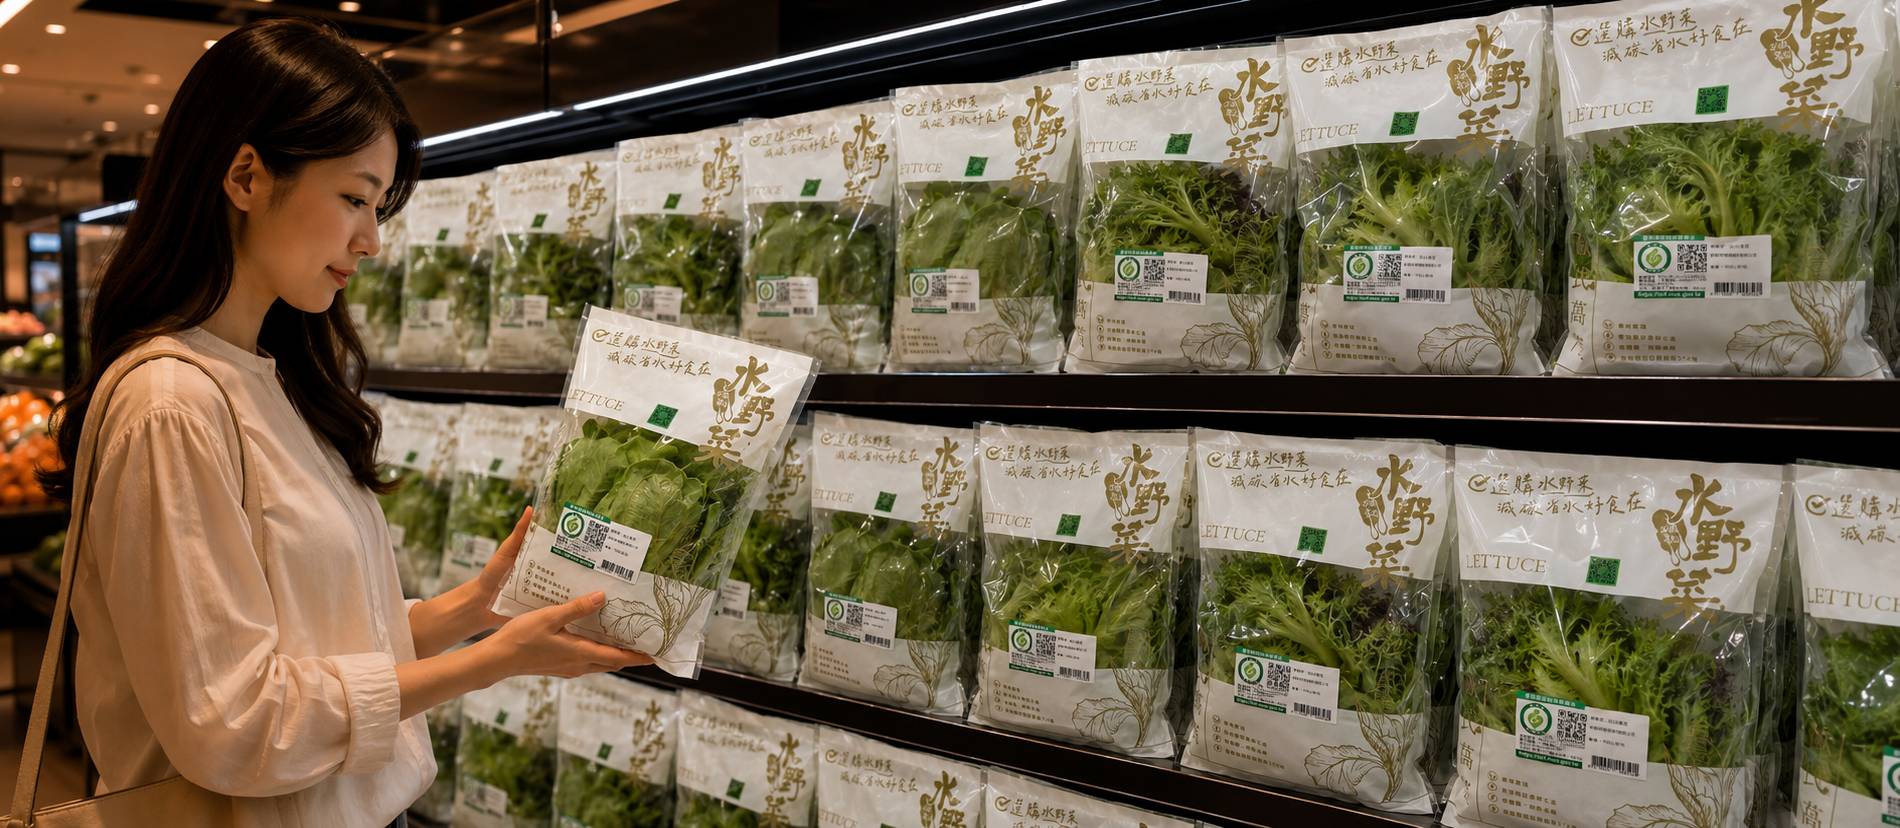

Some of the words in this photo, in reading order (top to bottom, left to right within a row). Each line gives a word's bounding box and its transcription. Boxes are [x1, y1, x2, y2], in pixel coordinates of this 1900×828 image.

[1220, 57, 1286, 176] 水野菜
[1455, 23, 1531, 155] 水野菜
[1567, 99, 1654, 126] LETTUCE
[691, 355, 775, 472] 水野菜
[1108, 443, 1170, 562] 水野菜
[1360, 453, 1436, 588] 水野菜
[1662, 472, 1751, 624] 水野菜
[1465, 553, 1547, 573] LETTUCE
